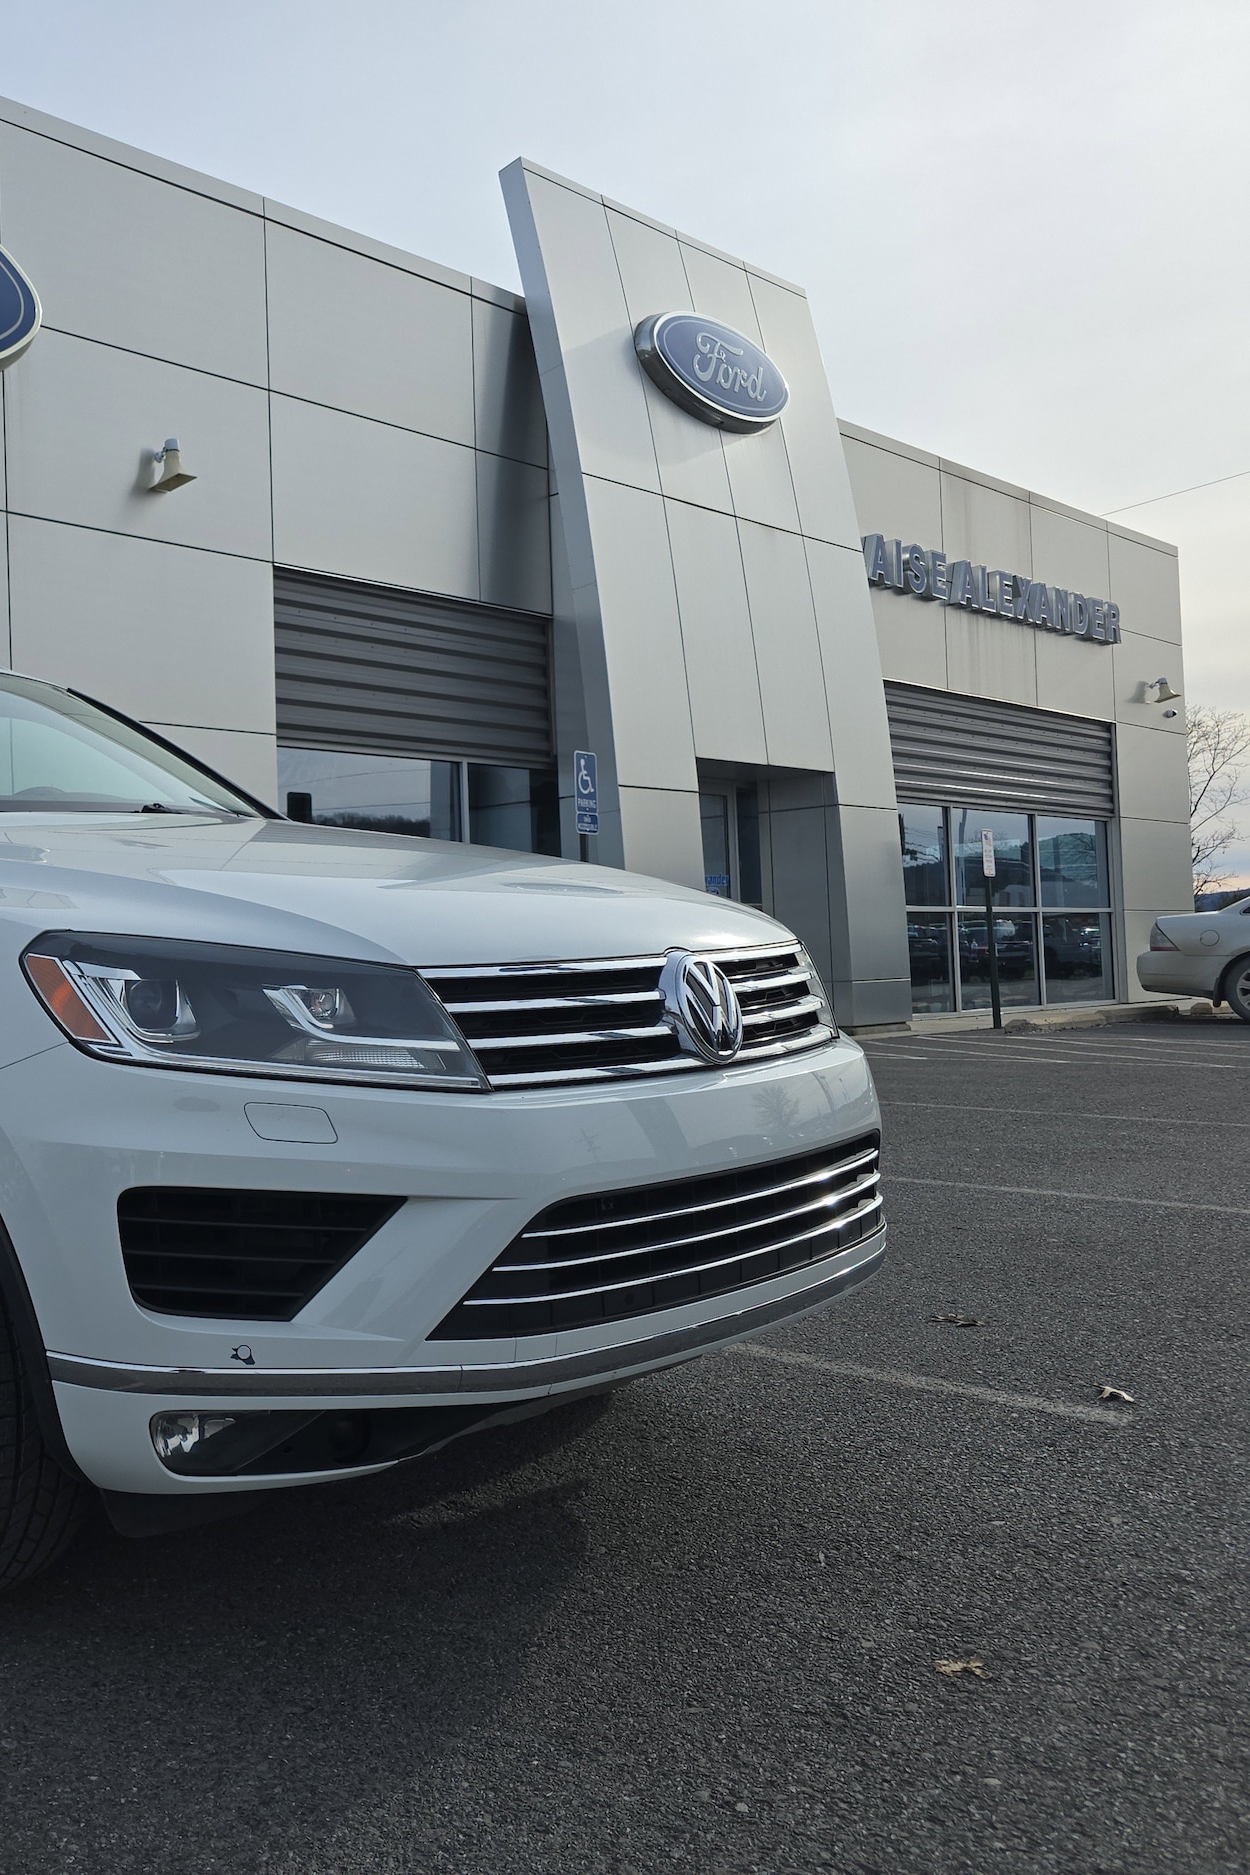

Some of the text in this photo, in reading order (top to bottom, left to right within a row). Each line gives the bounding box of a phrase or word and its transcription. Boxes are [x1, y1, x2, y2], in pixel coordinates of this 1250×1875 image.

[693, 332, 767, 402] Ford
[862, 533, 1122, 644] AISE ALEXANDER
[705, 872, 730, 887] ander
